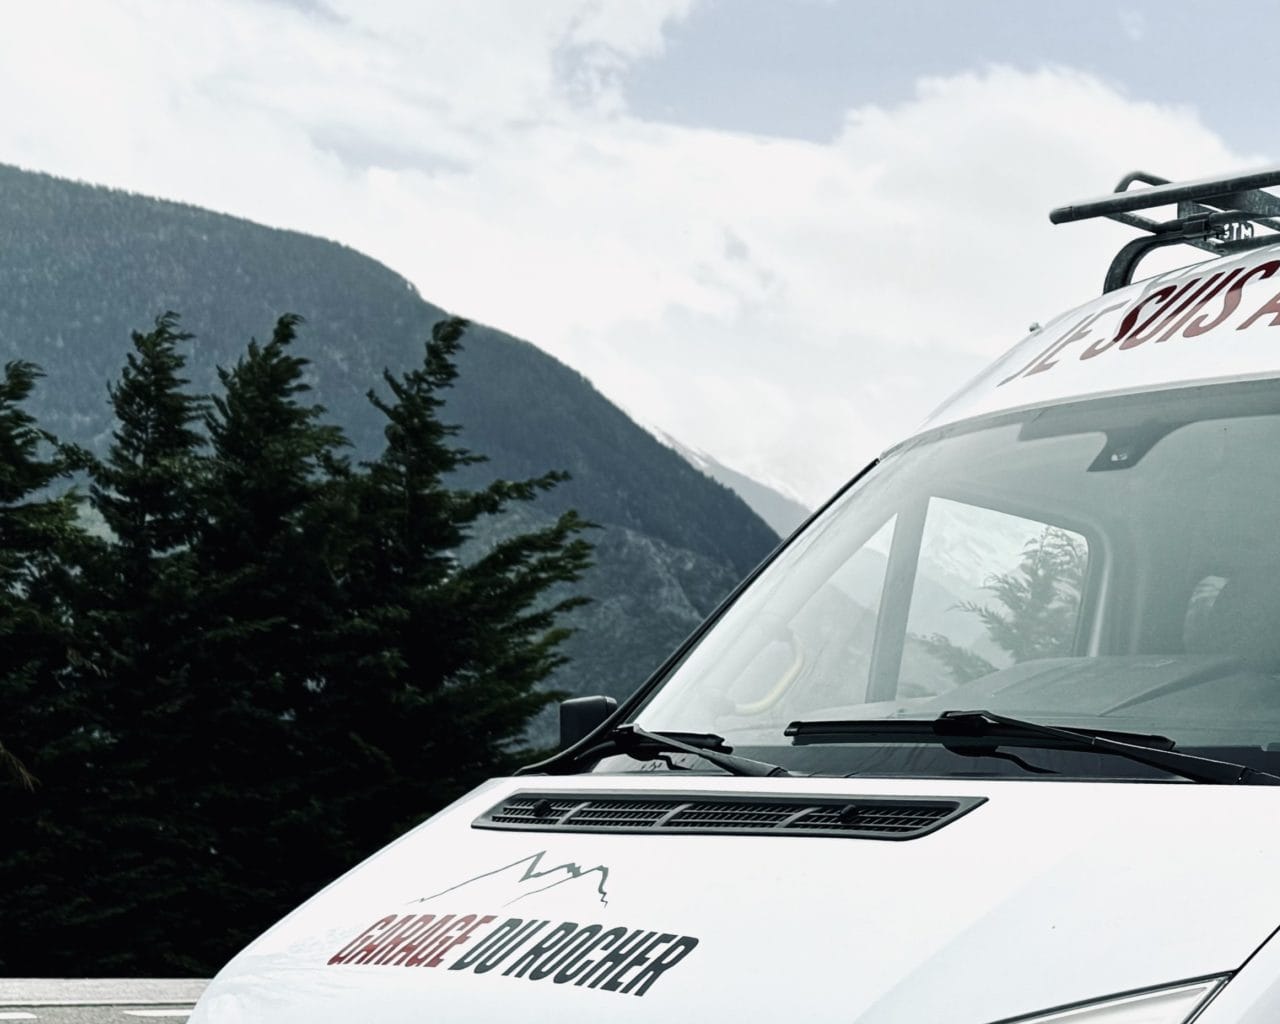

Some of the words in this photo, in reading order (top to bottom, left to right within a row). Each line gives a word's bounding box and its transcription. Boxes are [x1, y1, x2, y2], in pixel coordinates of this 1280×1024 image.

[996, 299, 1132, 387] JE
[327, 914, 499, 967] GARAGE
[448, 918, 550, 974] DU
[502, 921, 699, 996] ROCHER
